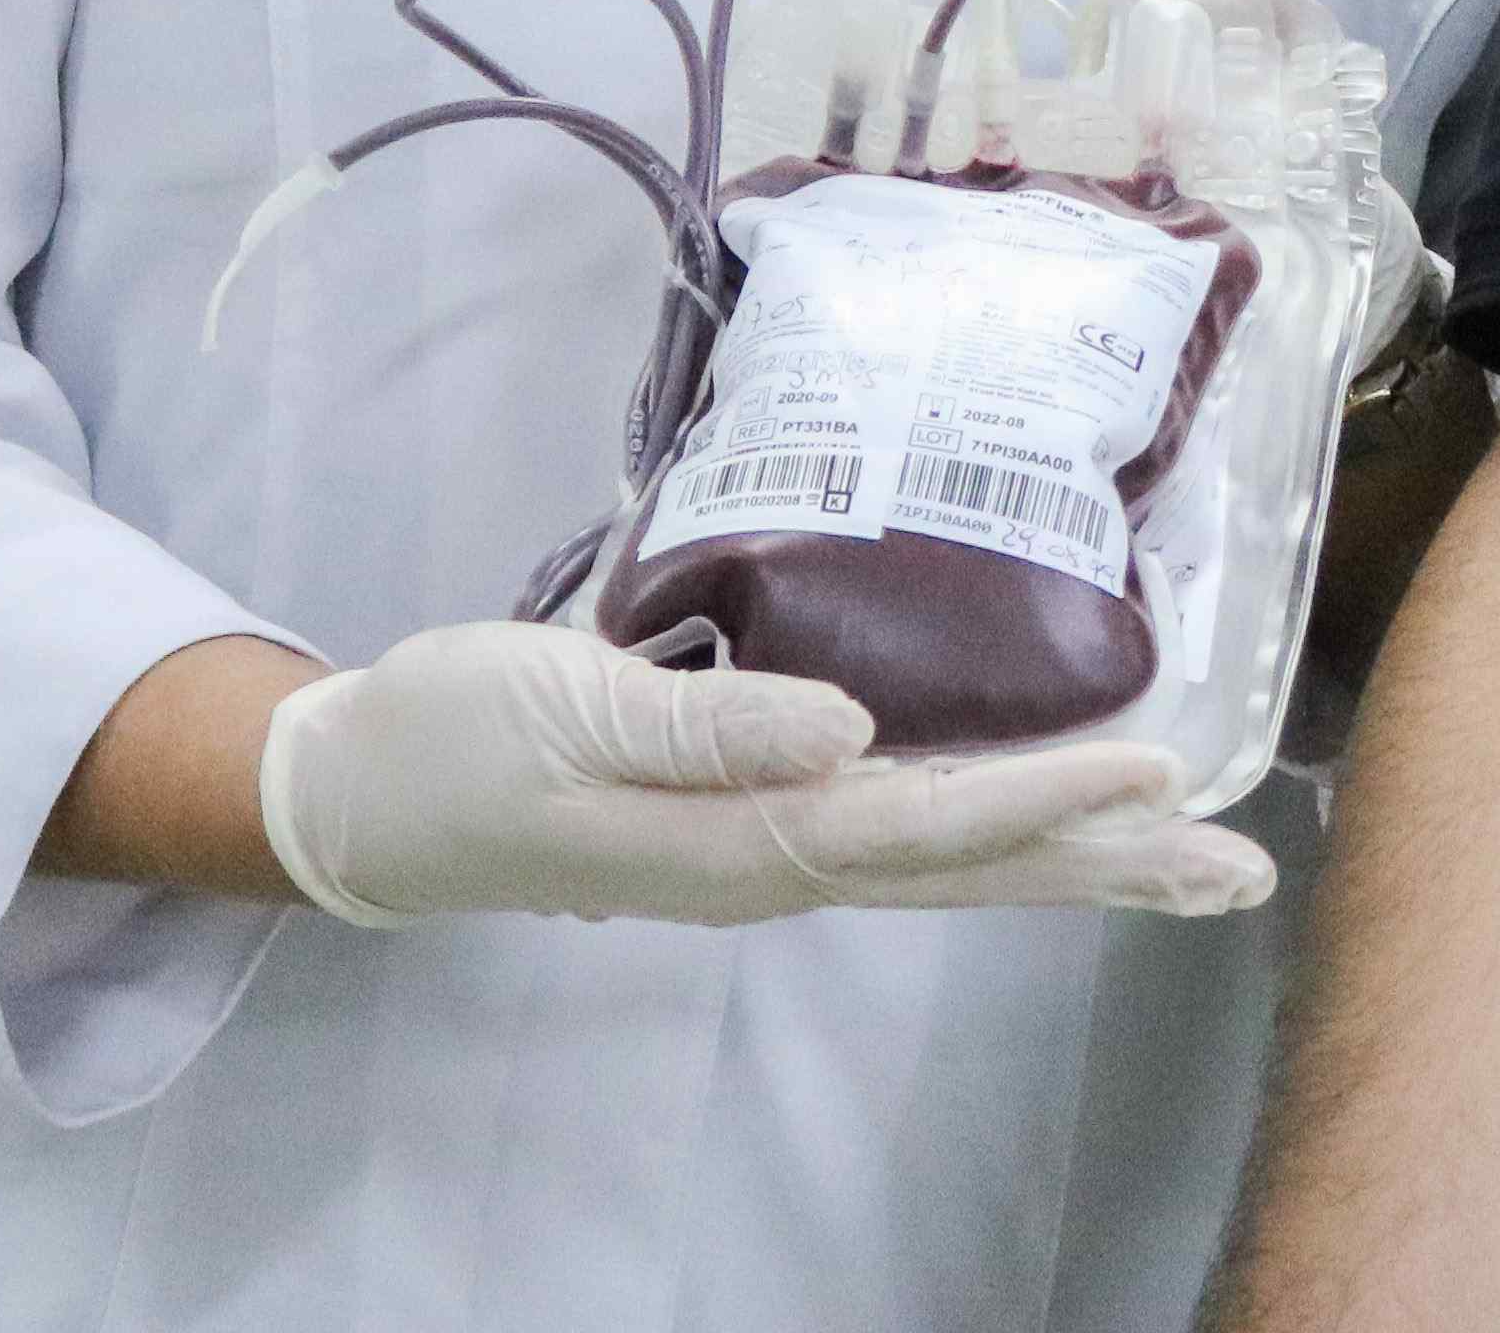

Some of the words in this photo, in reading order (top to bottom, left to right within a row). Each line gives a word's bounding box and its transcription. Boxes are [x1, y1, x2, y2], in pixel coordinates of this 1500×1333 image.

[777, 391, 839, 405] 2020-09
[963, 408, 1026, 429] 2022-08
[737, 424, 770, 440] REF
[782, 420, 859, 434] PT331BA
[915, 429, 954, 447] LOT
[971, 439, 1074, 473] 71PI30AA00
[828, 496, 842, 509] K
